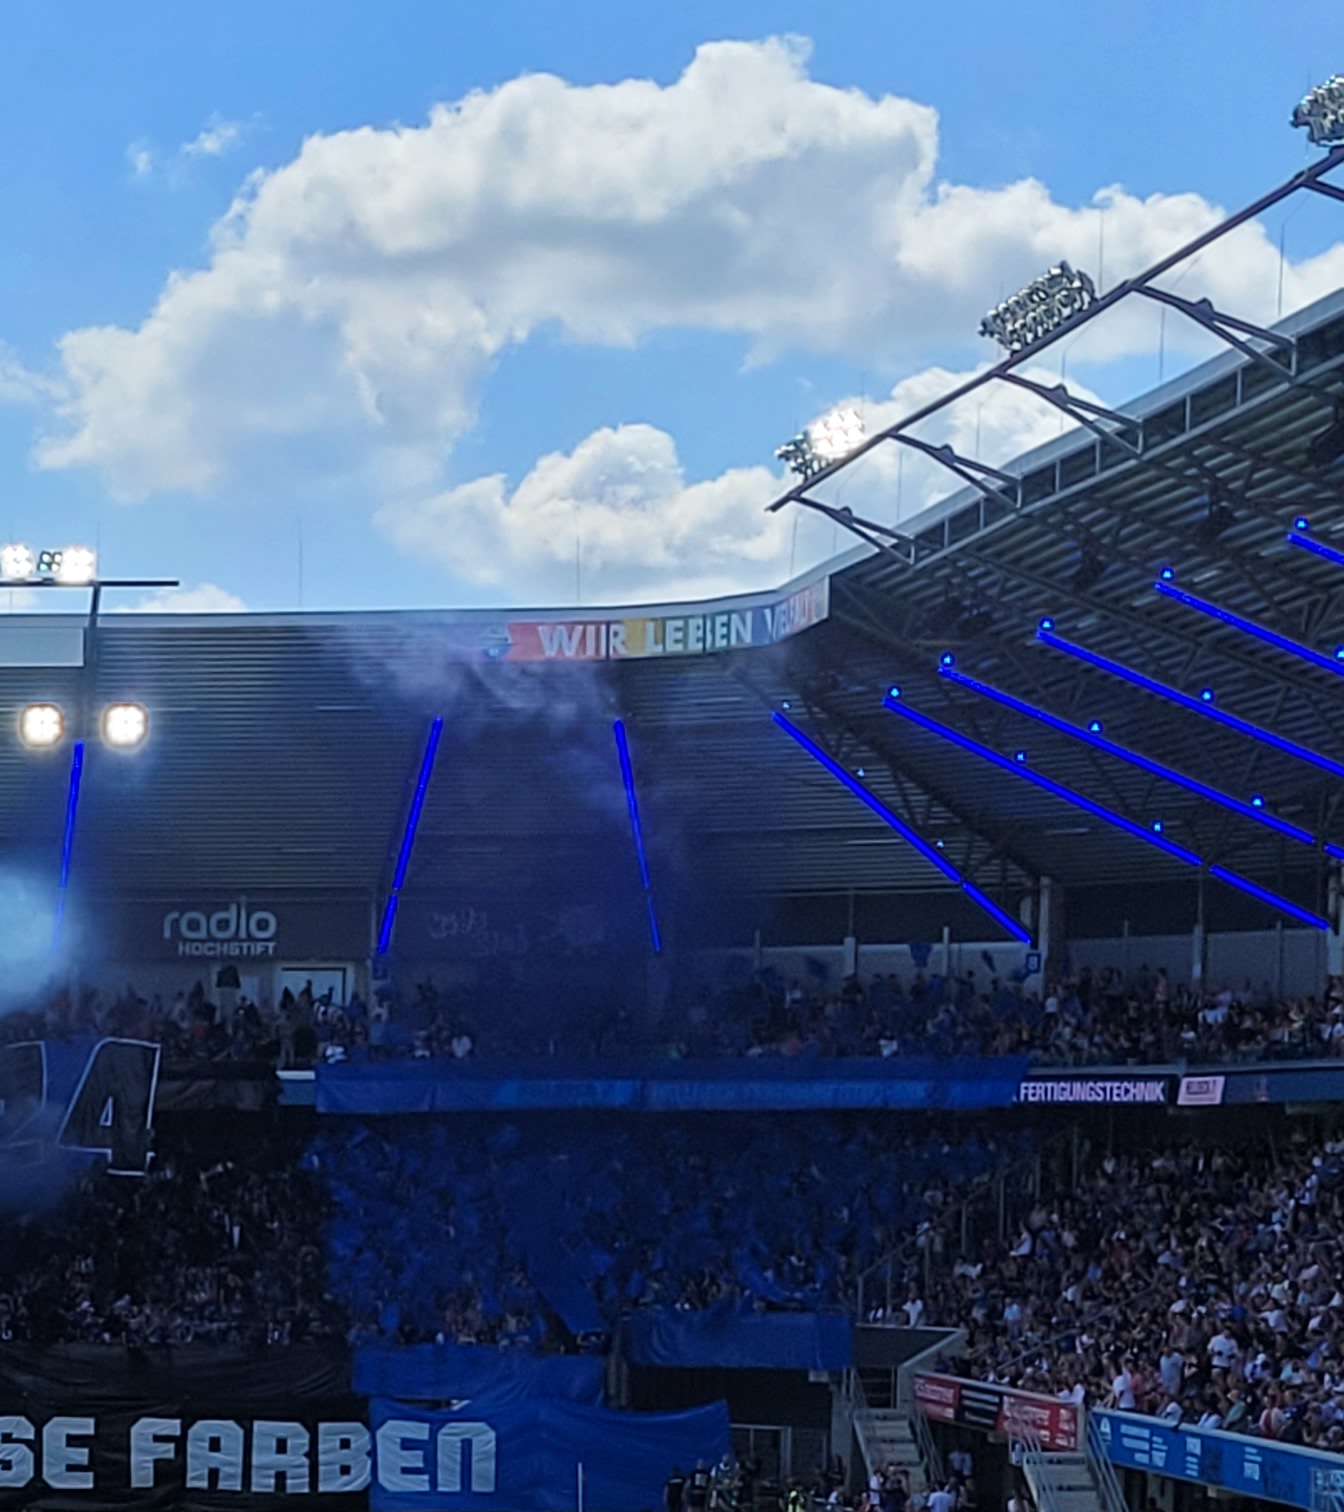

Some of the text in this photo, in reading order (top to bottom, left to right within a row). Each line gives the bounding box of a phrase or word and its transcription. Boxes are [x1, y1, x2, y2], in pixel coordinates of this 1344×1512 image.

[538, 623, 628, 657] WIR
[645, 611, 754, 652] LEBEN
[163, 896, 277, 940] radio
[1020, 1080, 1165, 1102] FERTIGUNGSTECHNIK
[130, 1416, 496, 1493] FARBEN
